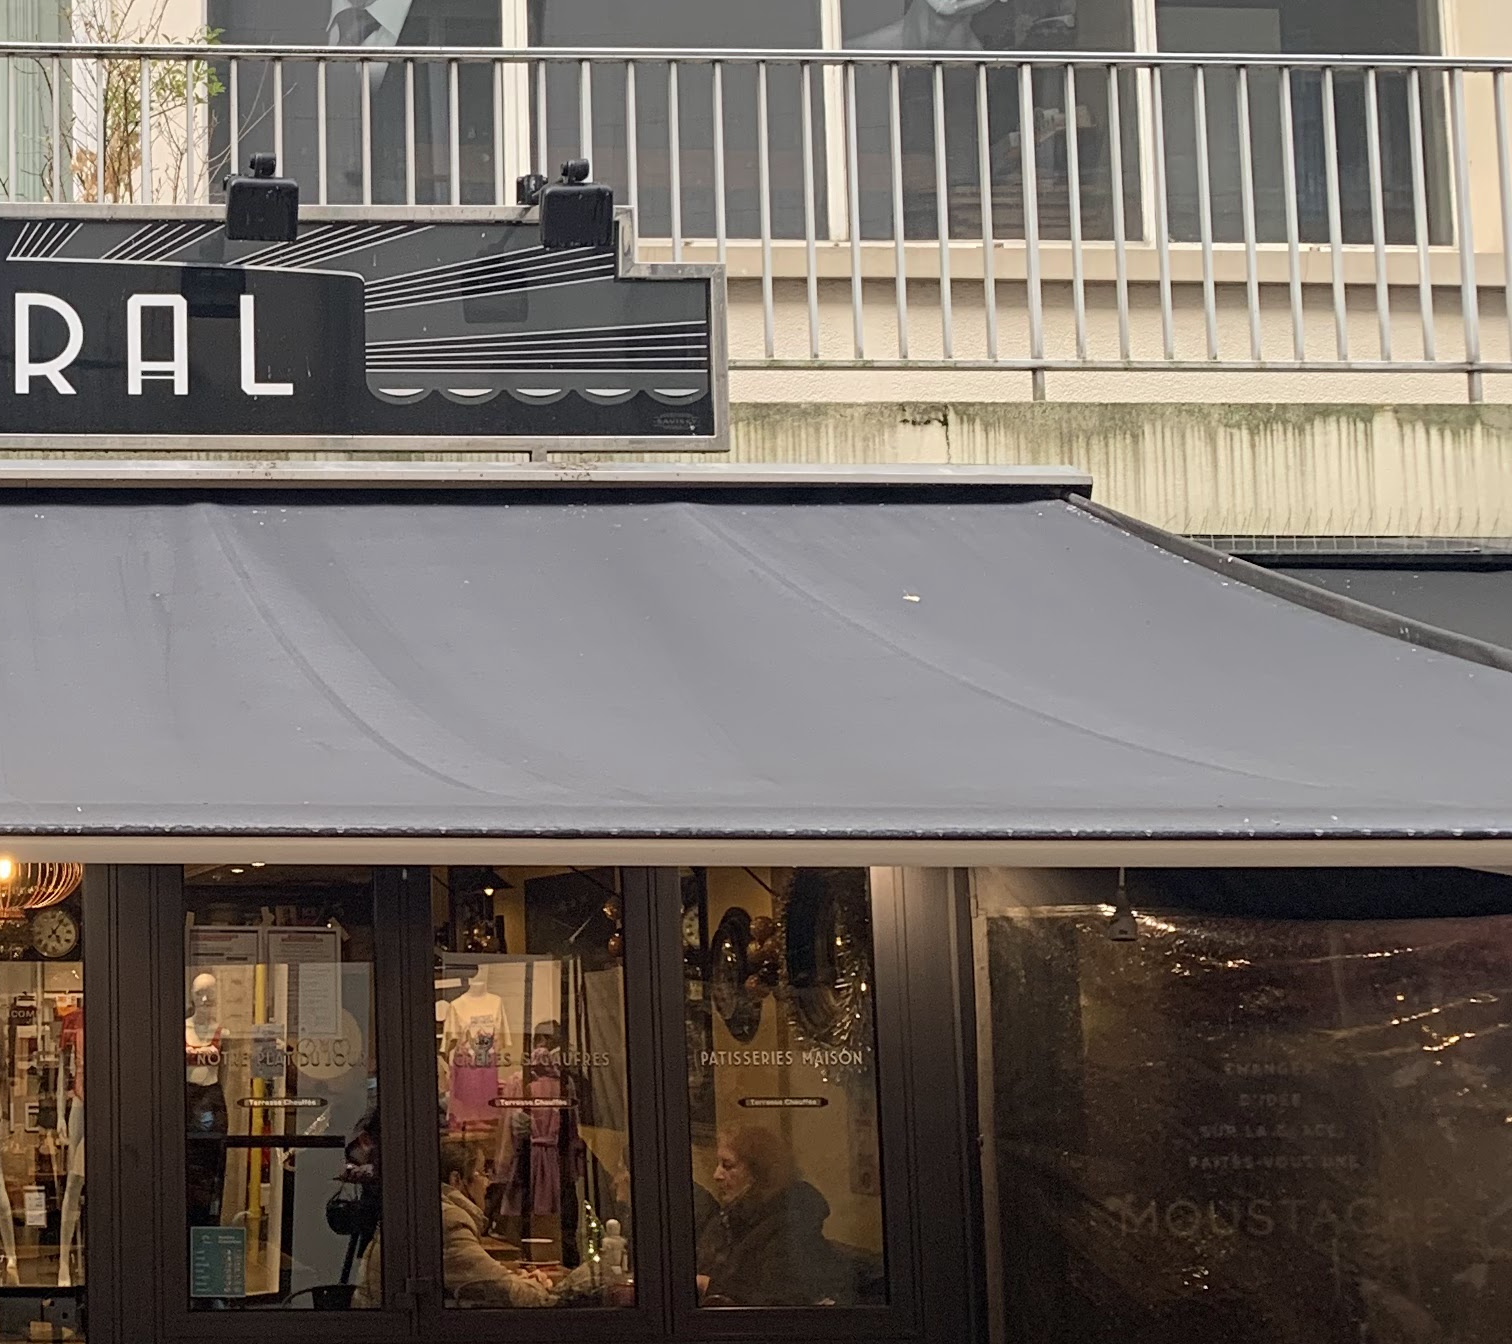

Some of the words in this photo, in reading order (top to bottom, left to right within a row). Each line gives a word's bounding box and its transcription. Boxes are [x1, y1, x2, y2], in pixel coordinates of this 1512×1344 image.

[196, 1052, 248, 1068] NOTRE
[258, 1052, 291, 1068] PLAT
[539, 1051, 611, 1067] GAUFRES
[700, 1050, 793, 1066] PATISSERIES
[801, 1050, 863, 1066] MAISON
